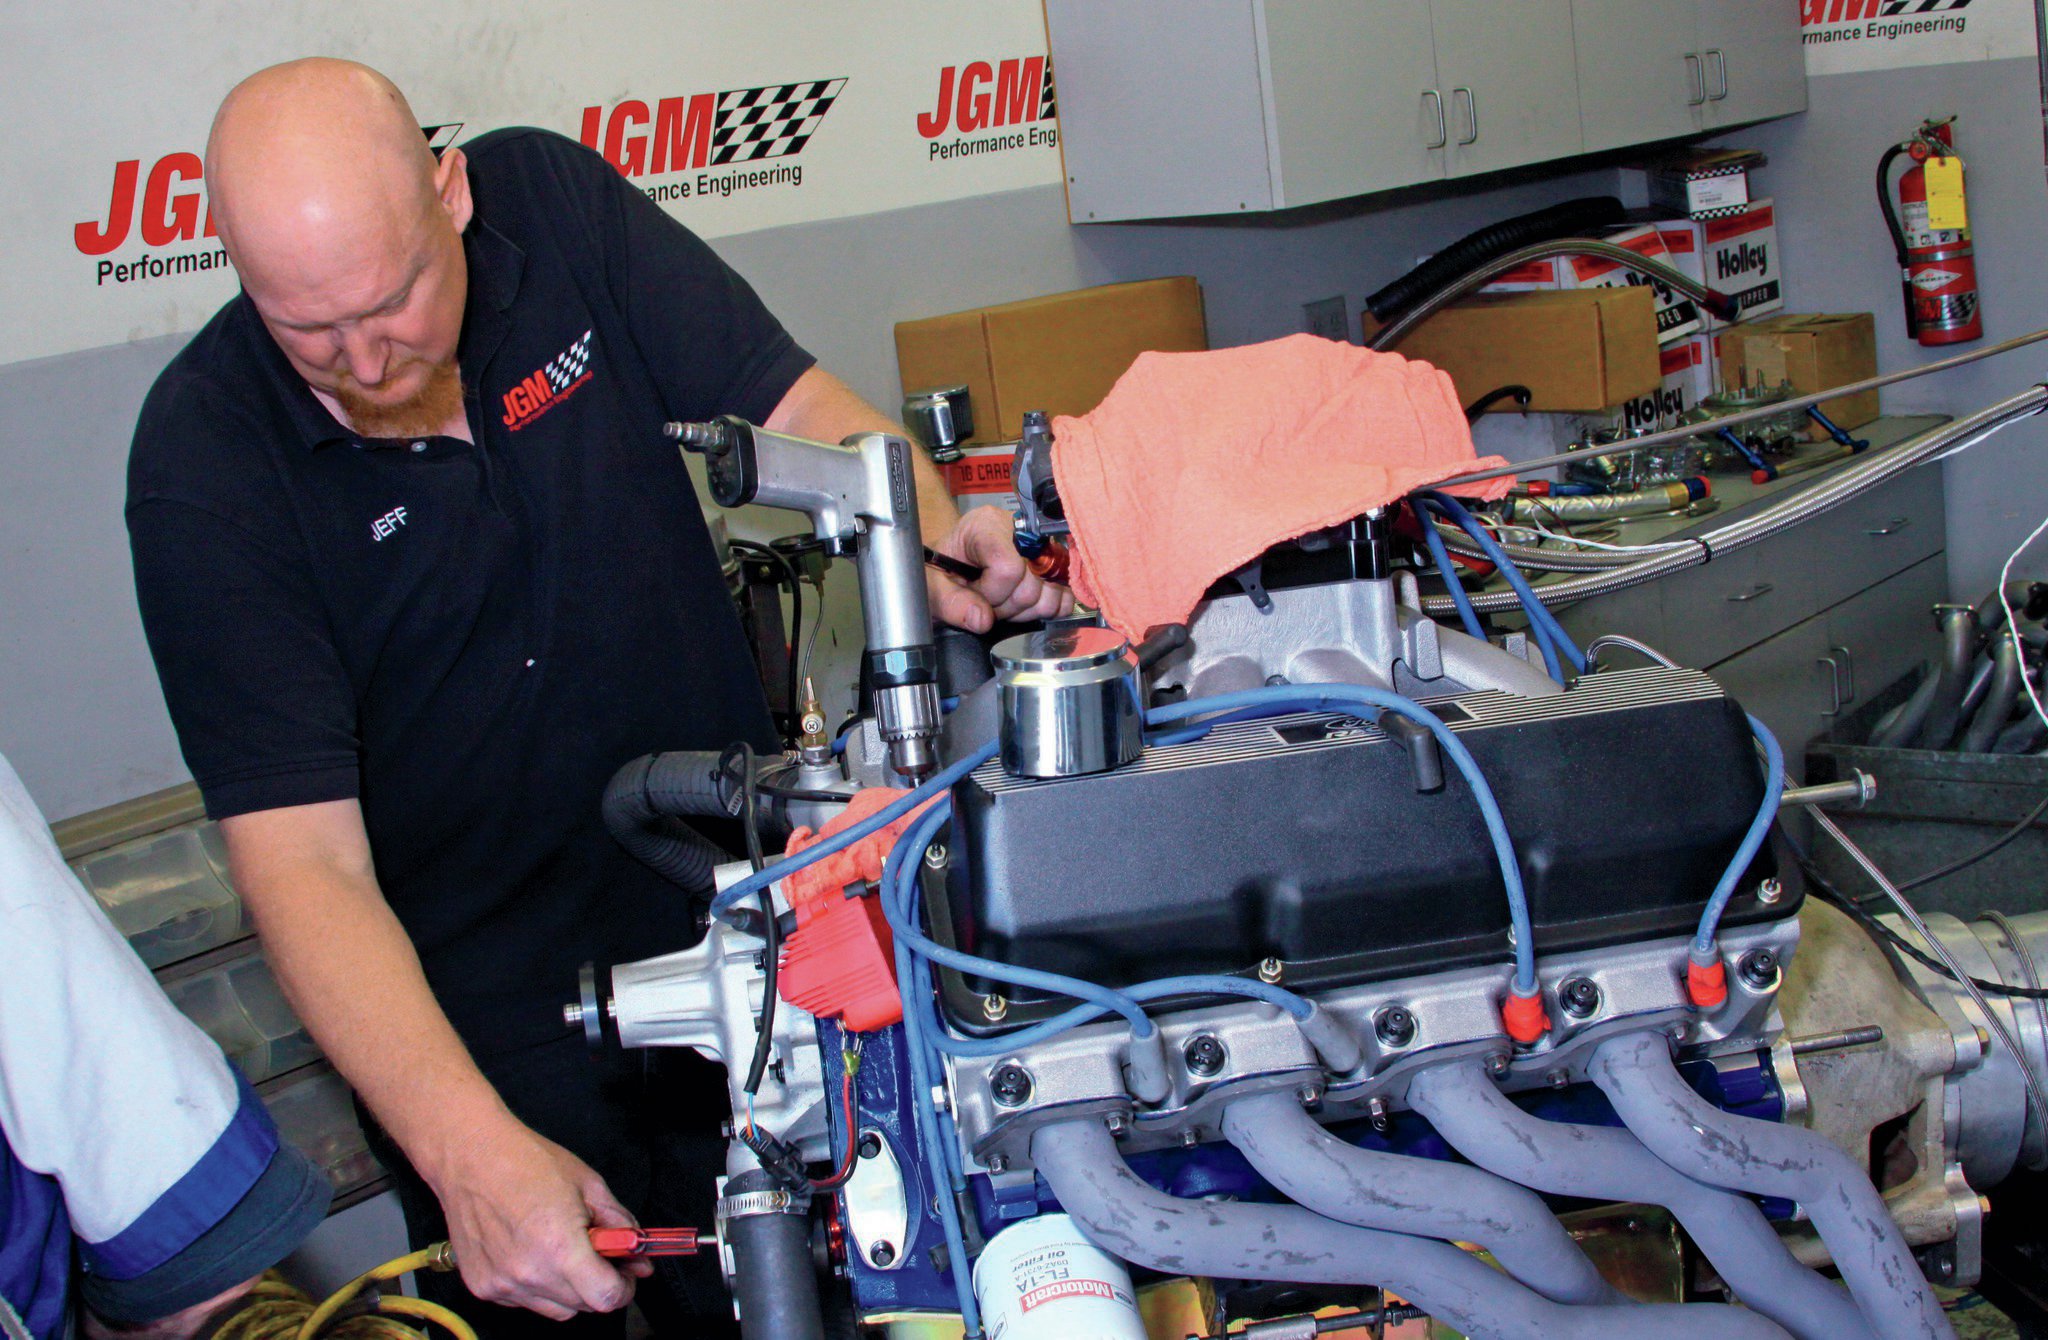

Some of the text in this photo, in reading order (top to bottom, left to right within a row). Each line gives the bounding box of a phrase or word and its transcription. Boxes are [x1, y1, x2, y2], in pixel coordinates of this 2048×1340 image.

[1866, 15, 1967, 40] Engineering
[917, 55, 1044, 139] JGM
[929, 126, 1060, 162] Performance Eng
[640, 163, 802, 202] ance Engineering
[74, 151, 218, 256] JG
[97, 249, 229, 287] Performan
[1716, 242, 1767, 281] Holley
[502, 369, 554, 426] JGM
[1624, 386, 1685, 430] Holley
[977, 462, 1012, 480] CARB
[370, 506, 408, 542] JEFF
[1012, 1250, 1065, 1273] Oil Filter
[1016, 1267, 1070, 1293] FL-1A
[1024, 1280, 1111, 1308] Motorcraft
